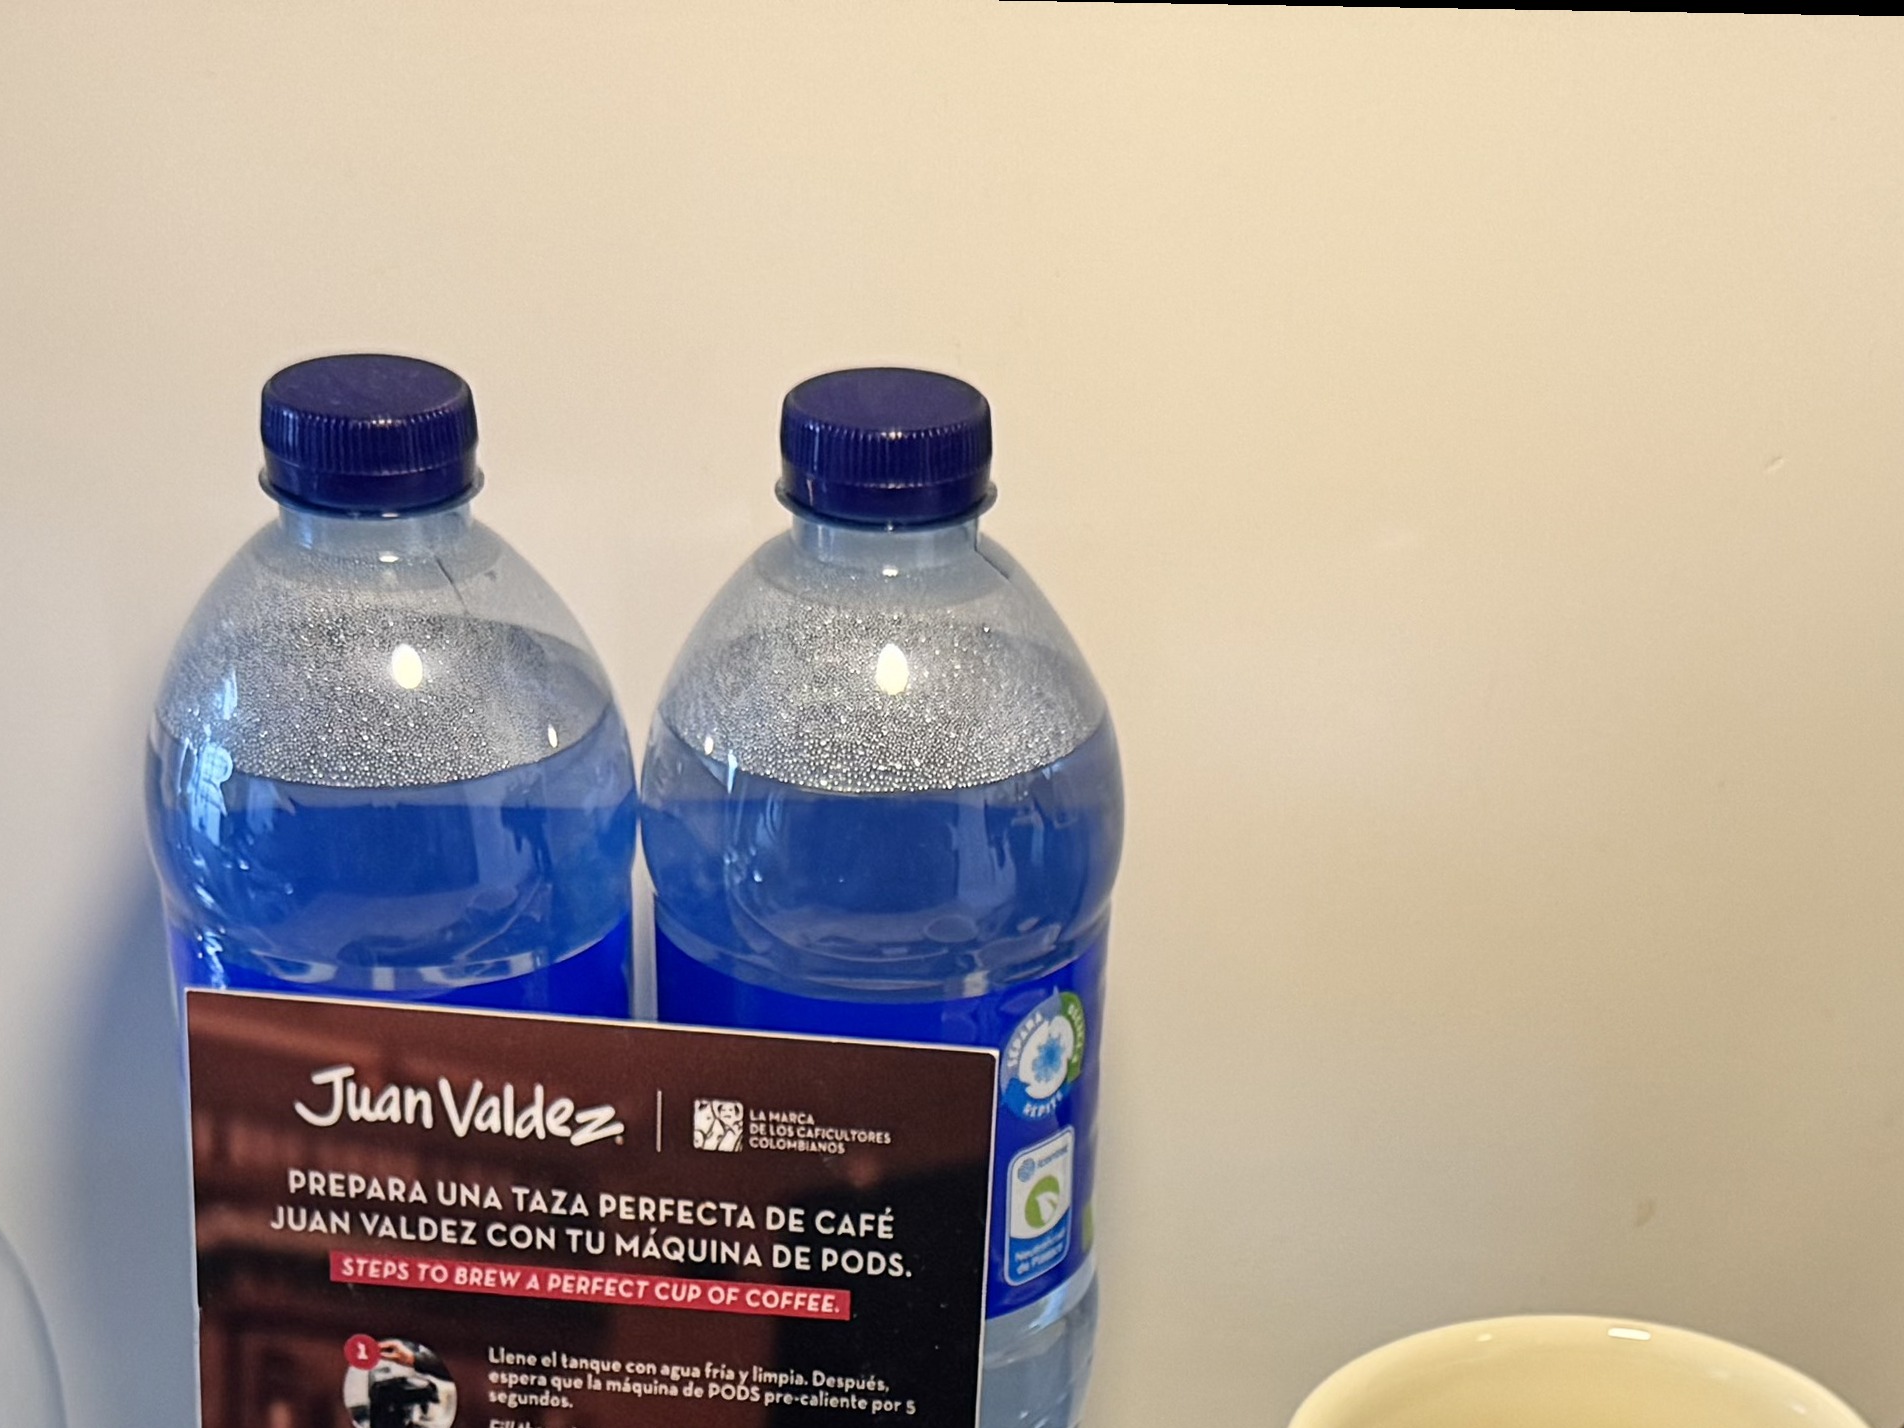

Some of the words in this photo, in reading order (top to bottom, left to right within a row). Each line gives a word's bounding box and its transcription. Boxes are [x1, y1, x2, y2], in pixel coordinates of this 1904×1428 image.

[293, 1063, 434, 1129] Juan
[437, 1076, 625, 1146] Valdez
[749, 1109, 766, 1122] LA
[769, 1111, 815, 1125] MARCA
[749, 1137, 846, 1154] COLOMBIANOS
[750, 1123, 766, 1136] DE
[769, 1124, 794, 1137] LOS
[796, 1126, 892, 1144] CAFICULTORES
[288, 1168, 428, 1204] PREPARA
[437, 1180, 504, 1211] UNA
[511, 1186, 589, 1218] TAZA
[599, 1192, 756, 1230] PERFECTA
[766, 1205, 805, 1233] DE
[815, 1206, 895, 1239] CAFÉ
[270, 1205, 351, 1235] JUAN
[359, 1212, 478, 1246] VALDEZ
[486, 1223, 556, 1251] CON
[565, 1228, 605, 1255] TU
[615, 1228, 763, 1268] MÁQUINA
[772, 1244, 812, 1271] DE
[821, 1247, 913, 1278] PODS.
[341, 1256, 410, 1281] STEPS
[416, 1262, 448, 1284] TO
[455, 1267, 522, 1289] BREW
[525, 1272, 541, 1291] A
[546, 1273, 649, 1299] PERFECT
[654, 1280, 702, 1303] CUP
[707, 1285, 740, 1306] OF
[745, 1288, 841, 1313] COFFEE.
[356, 1342, 369, 1361] 1
[488, 1346, 537, 1367] Llene
[541, 1351, 557, 1368] el
[561, 1352, 622, 1375] tanque
[625, 1360, 657, 1375] con
[660, 1363, 701, 1381] agua
[738, 1370, 749, 1386] y
[752, 1365, 809, 1387] limpia.
[812, 1370, 890, 1393] Después,
[487, 1390, 574, 1408] segundos.
[488, 1370, 547, 1388] espera
[551, 1375, 583, 1392] que
[587, 1373, 602, 1391] la
[605, 1377, 679, 1398] máquina
[682, 1381, 704, 1398] de
[708, 1383, 760, 1402] PODS
[764, 1390, 868, 1411] pre-caliente
[871, 1399, 902, 1414] por
[905, 1400, 916, 1416] 5
